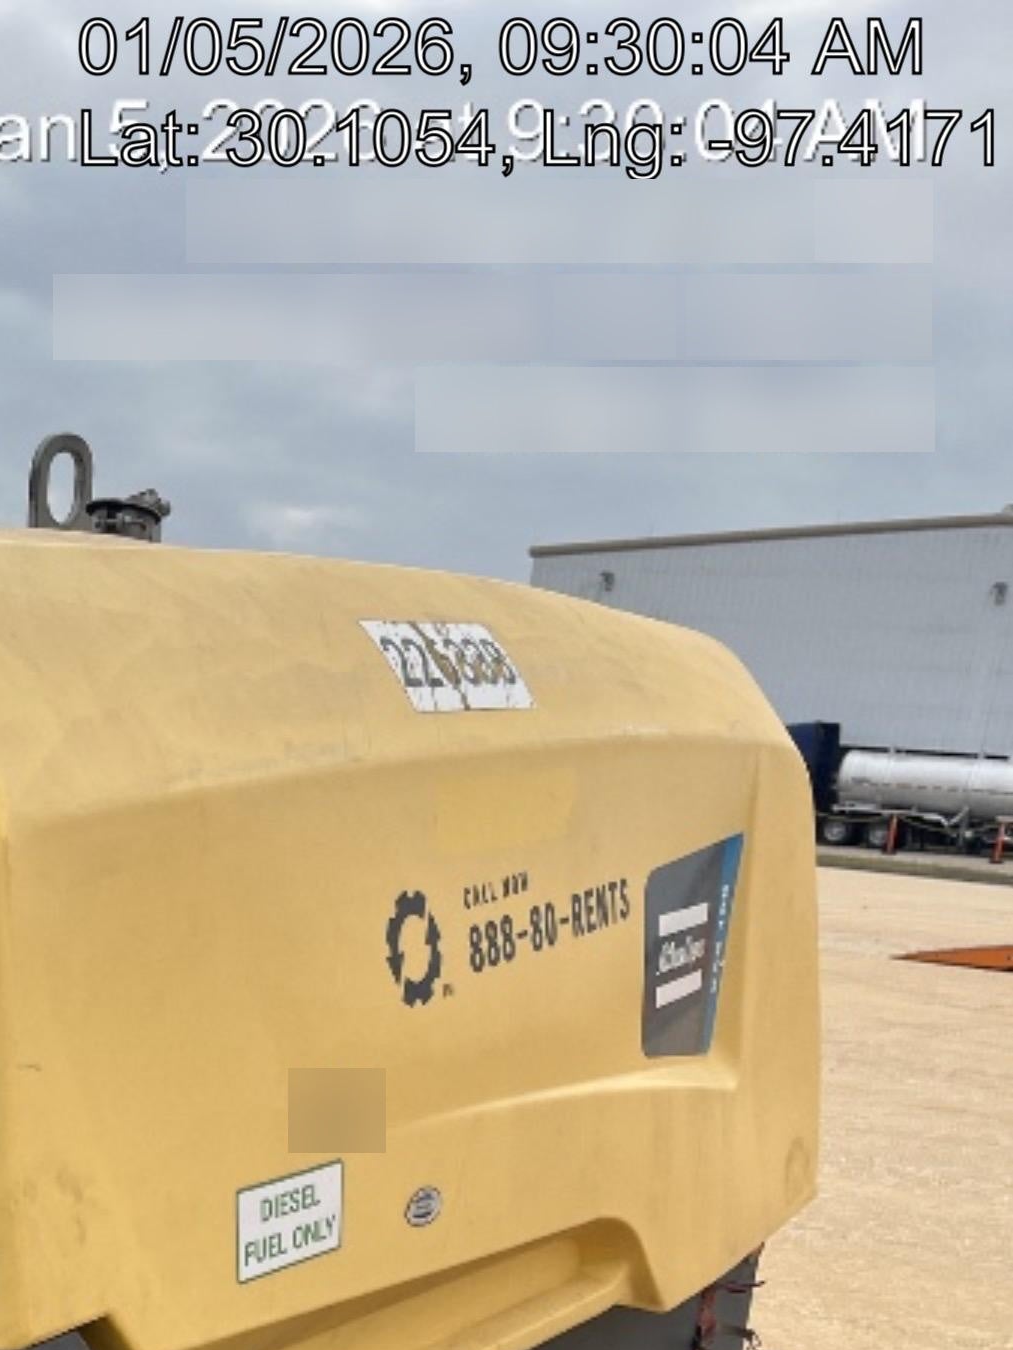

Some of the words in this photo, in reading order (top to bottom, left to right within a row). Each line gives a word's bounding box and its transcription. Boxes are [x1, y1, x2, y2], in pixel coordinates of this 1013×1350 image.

[463, 882, 498, 910] CALL
[502, 872, 529, 898] NOW
[469, 878, 631, 973] 888-80-RENTS
[259, 1183, 321, 1223] DIESEL
[243, 1232, 288, 1268] FUEL
[292, 1213, 336, 1251] ONLY
